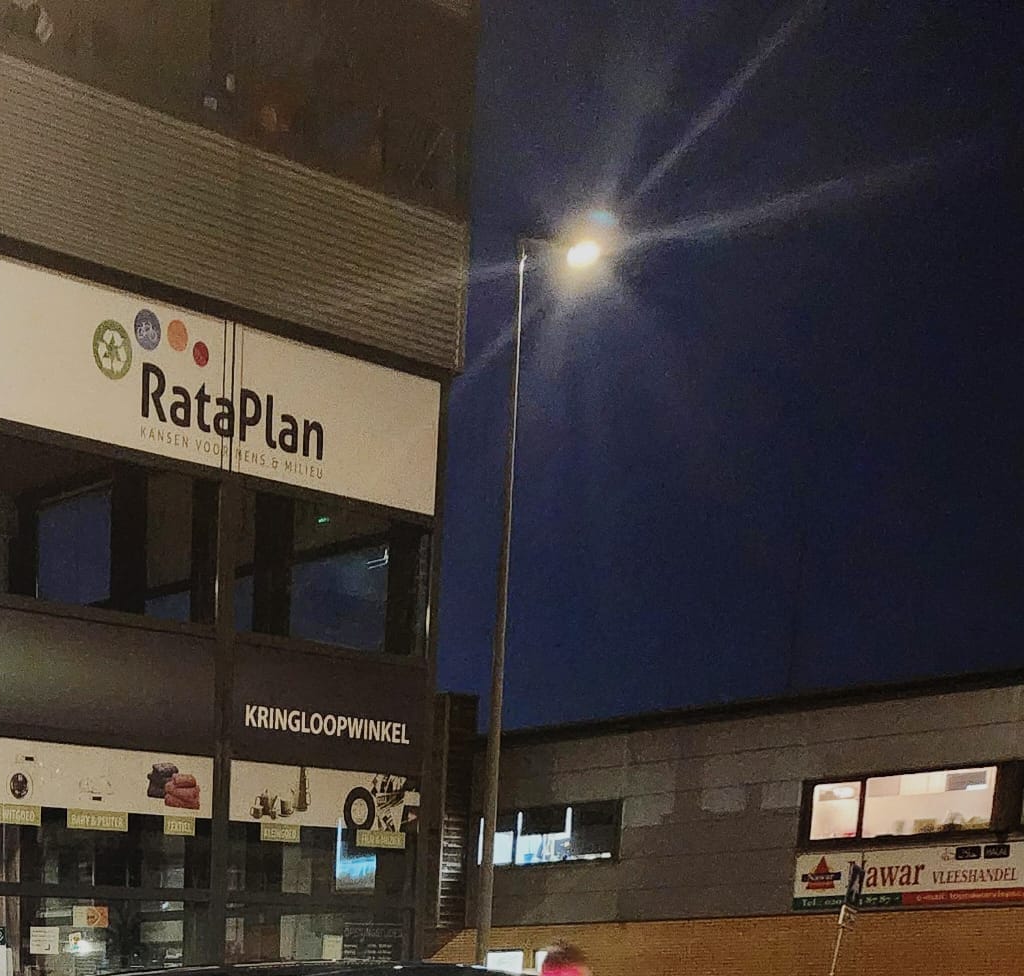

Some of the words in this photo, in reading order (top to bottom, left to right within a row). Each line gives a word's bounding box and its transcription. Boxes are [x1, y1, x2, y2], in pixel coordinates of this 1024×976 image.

[141, 362, 324, 460] RataPlan
[140, 425, 189, 449] KANSEN
[195, 438, 227, 457] VOOR
[284, 460, 323, 480] MILIEU
[244, 704, 410, 745] KRINGLOOPWINKEL
[932, 867, 1018, 885] VLEESHANDEL
